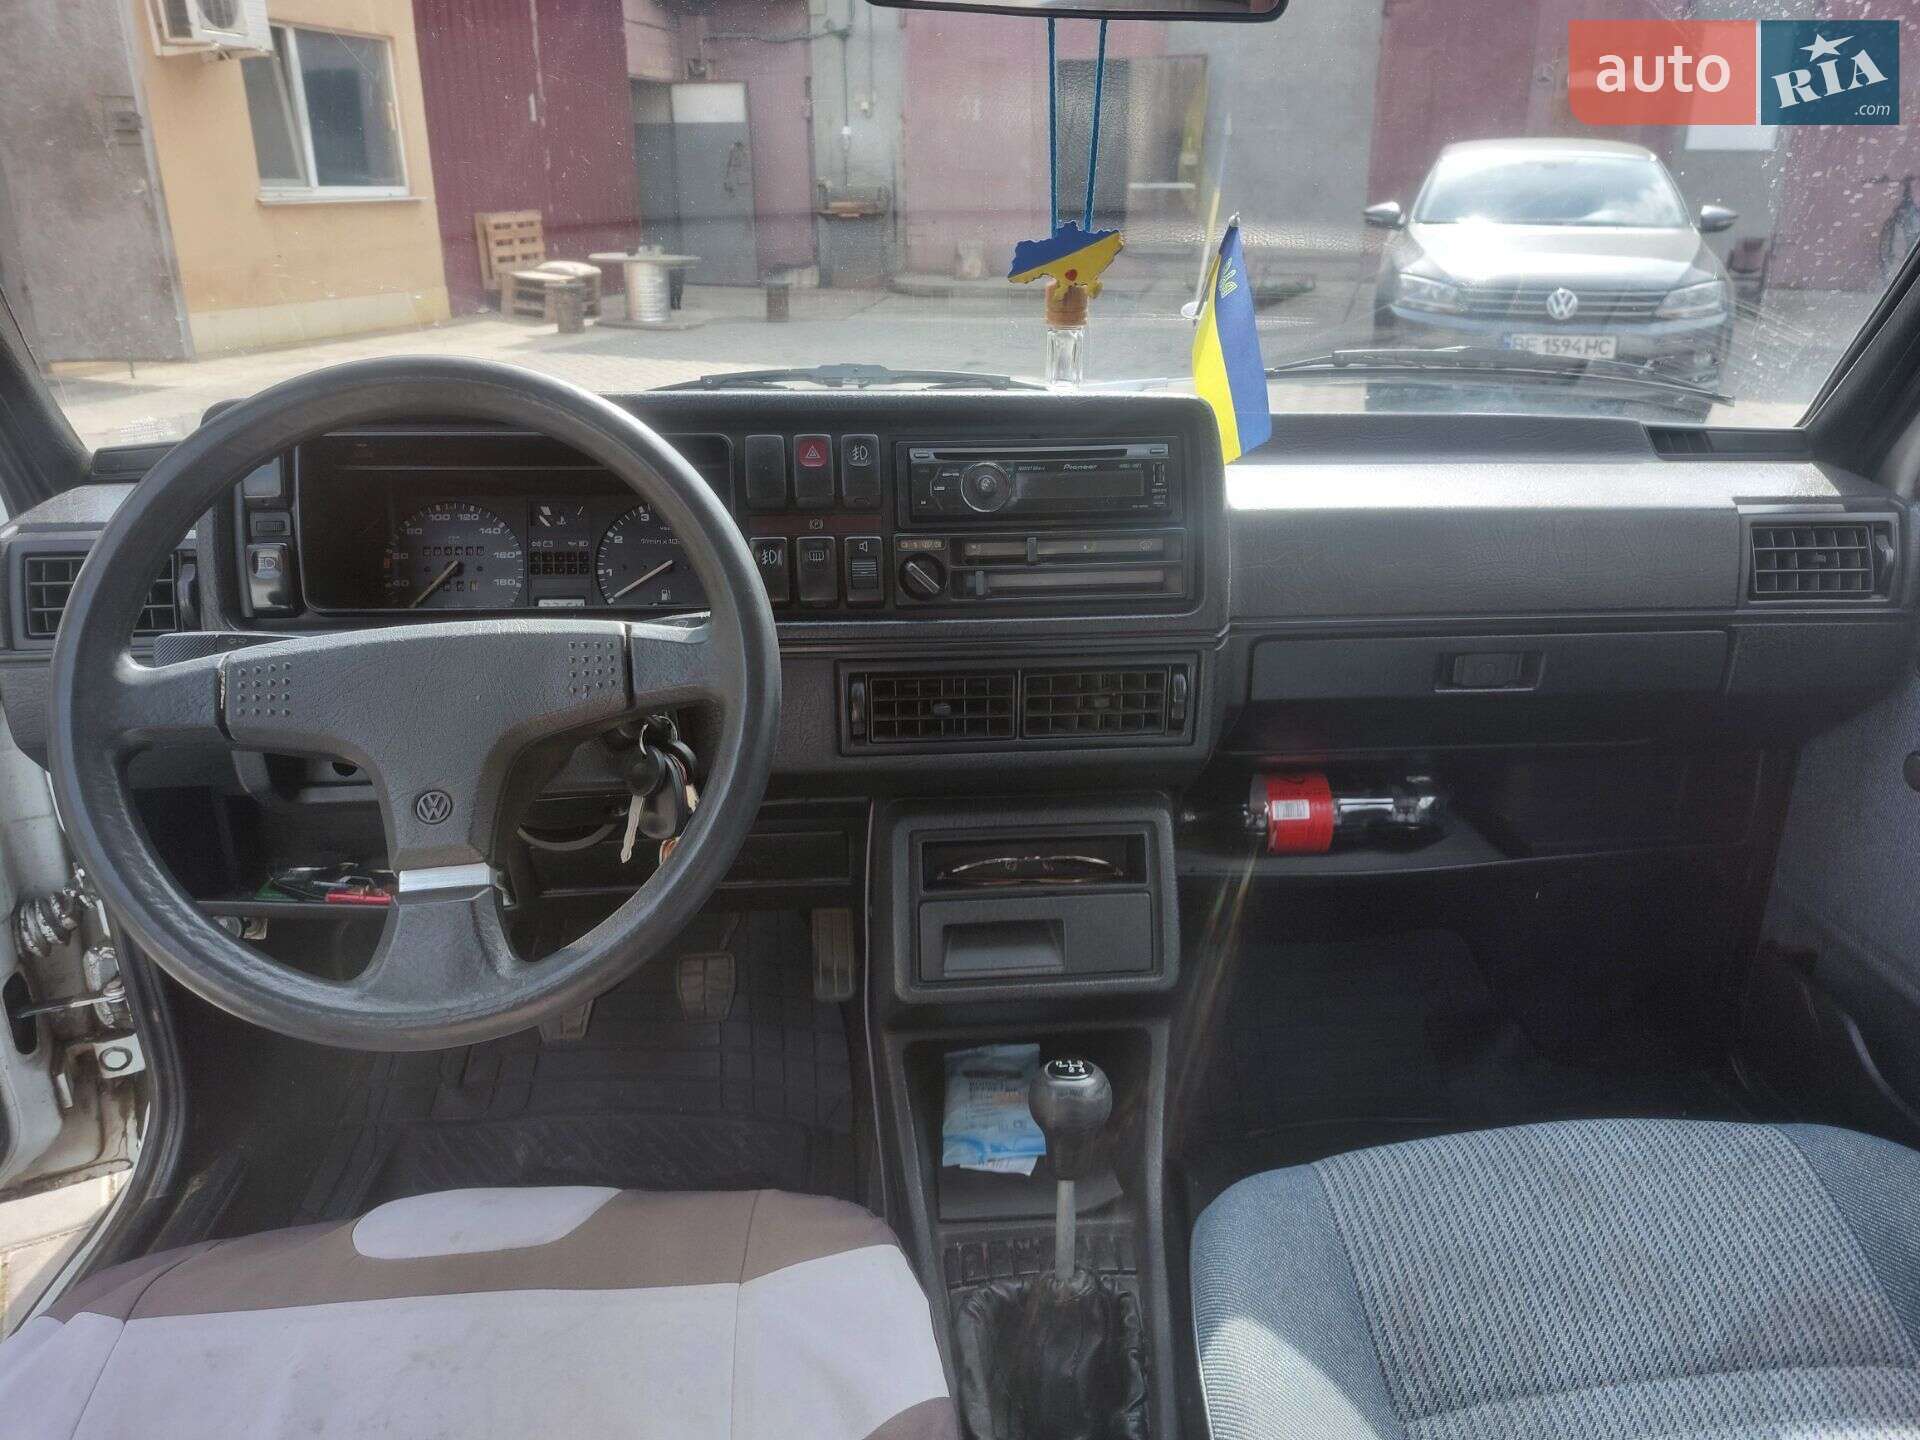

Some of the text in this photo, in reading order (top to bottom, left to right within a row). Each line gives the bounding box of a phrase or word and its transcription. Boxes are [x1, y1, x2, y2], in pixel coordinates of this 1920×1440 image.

[1543, 337, 1582, 354] 1594
[1584, 338, 1610, 356] HC
[1063, 463, 1097, 472] Pioneer
[640, 513, 650, 522] 3
[614, 535, 623, 544] 2
[605, 569, 613, 577] 1
